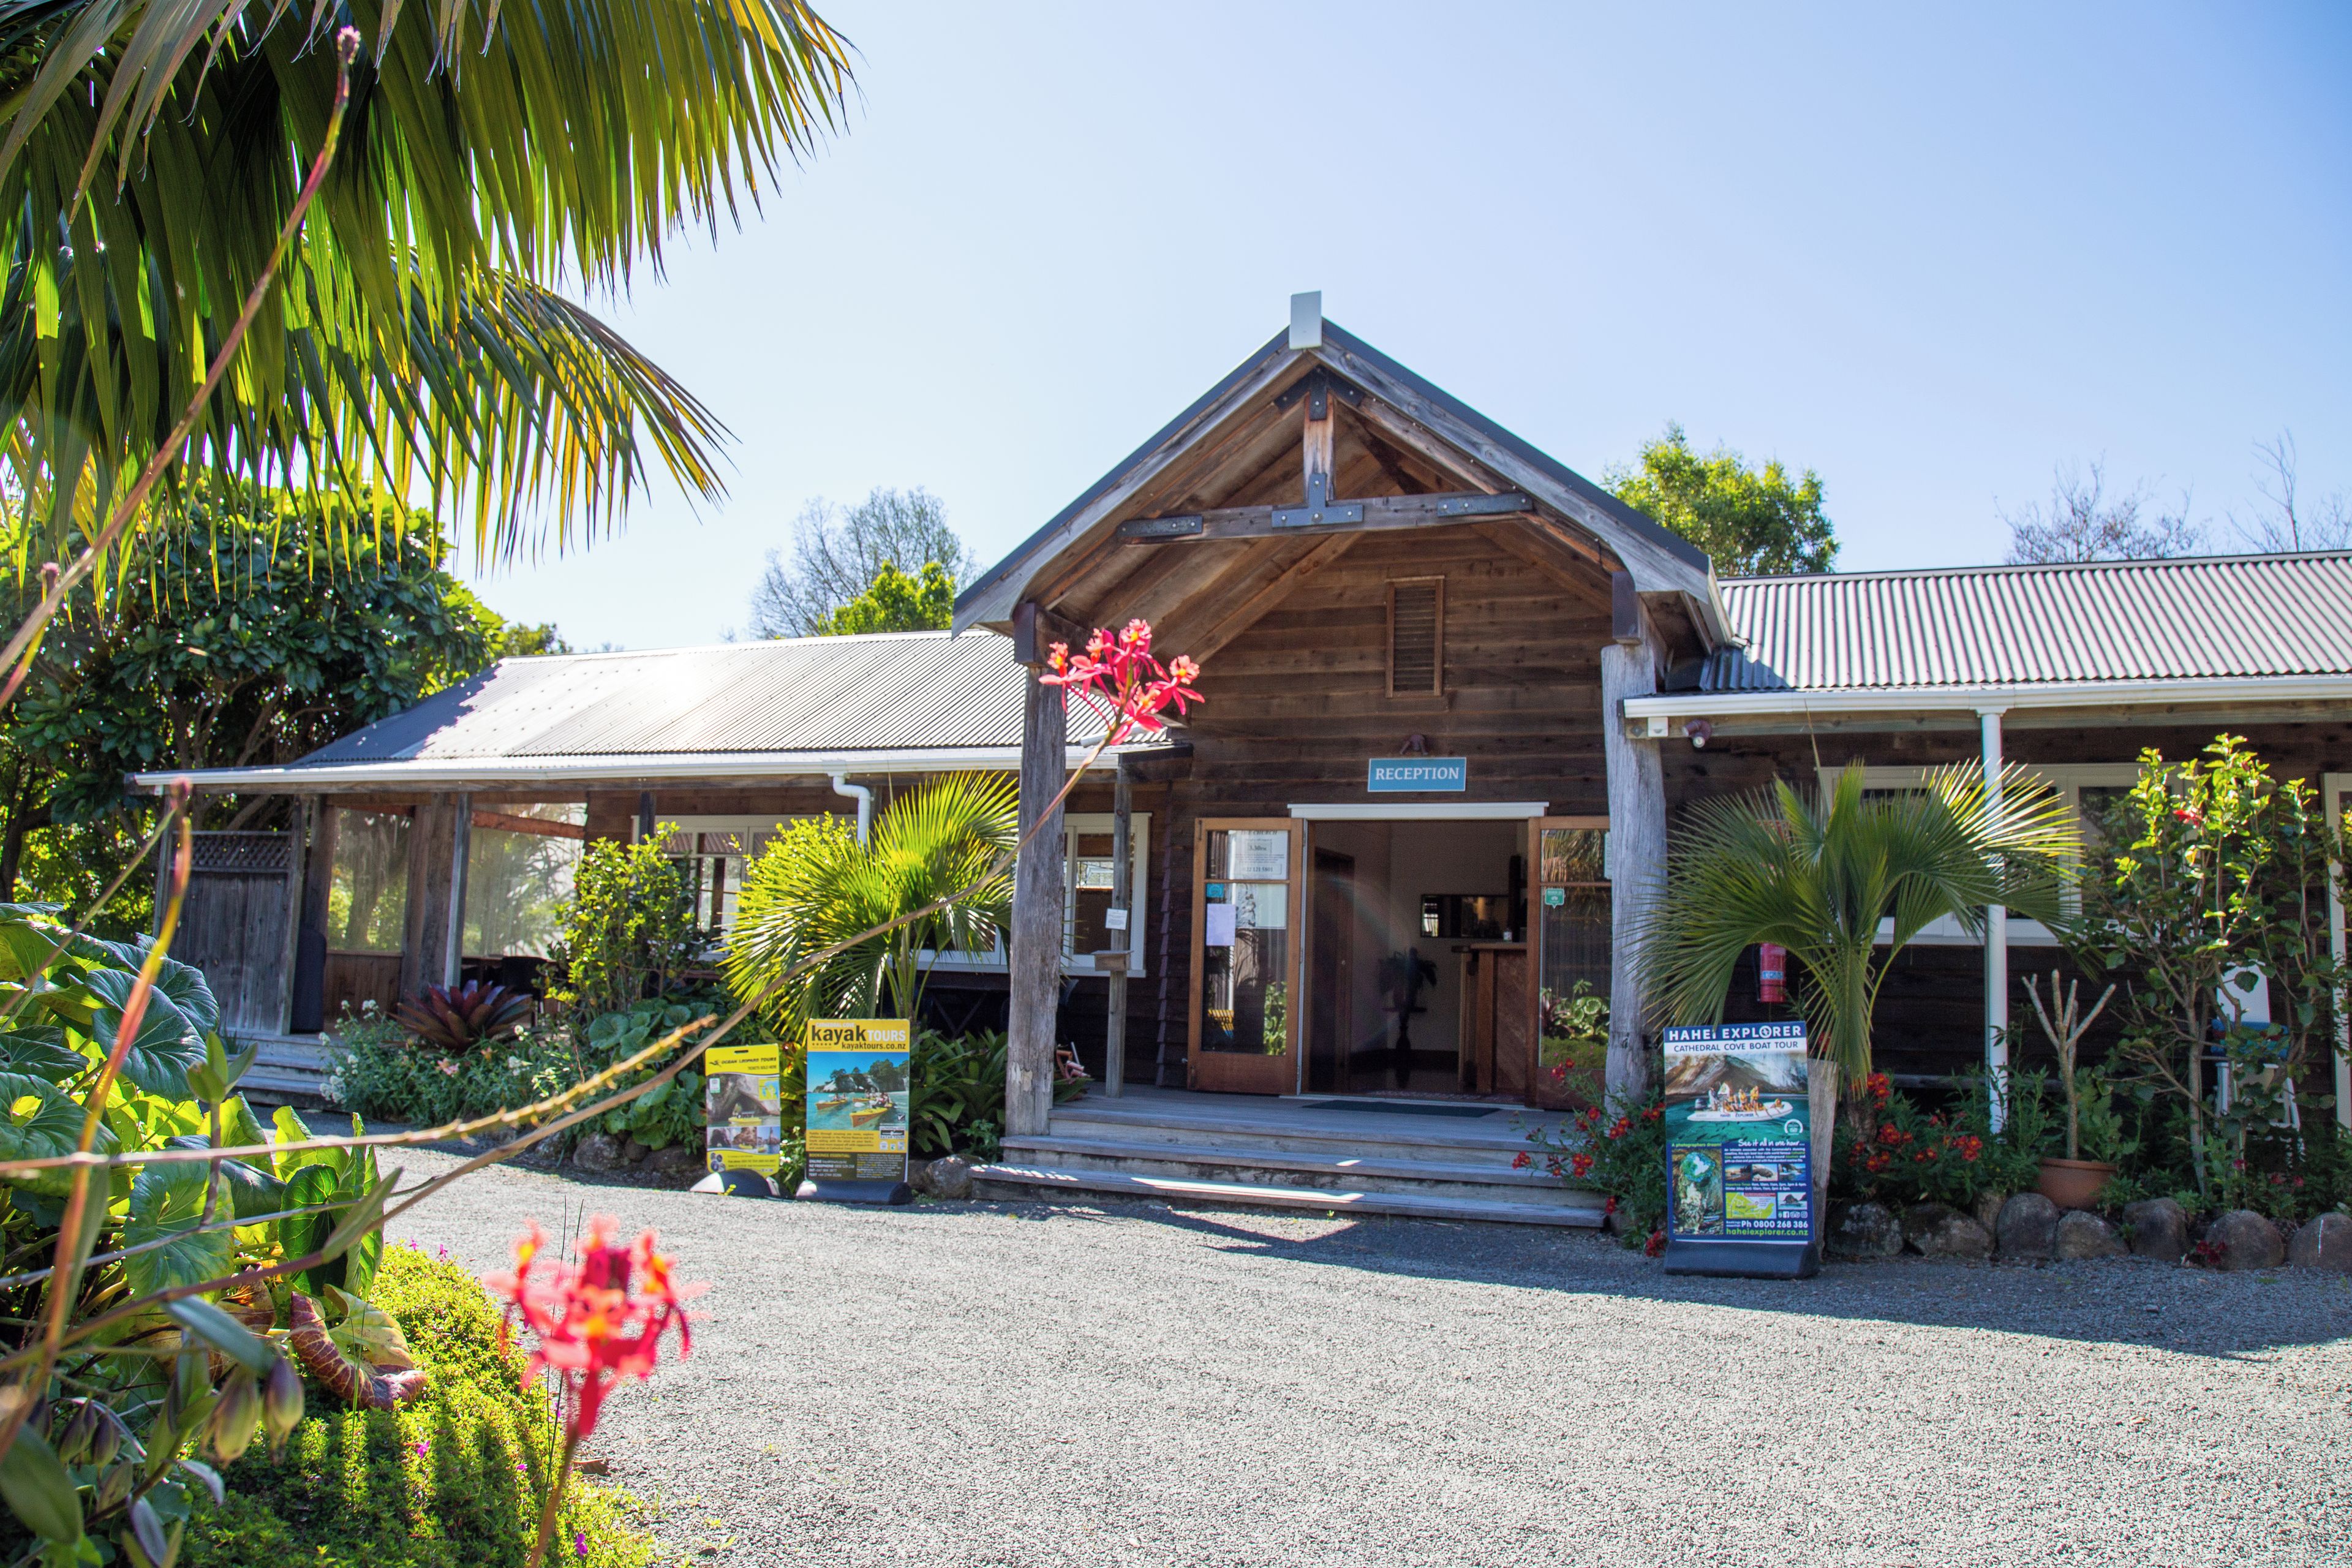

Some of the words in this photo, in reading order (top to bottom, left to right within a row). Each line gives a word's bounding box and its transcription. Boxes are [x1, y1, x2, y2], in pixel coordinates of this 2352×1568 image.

[1375, 767, 1460, 780] RECEPTION
[812, 1025, 866, 1045] kayak
[867, 1030, 906, 1041] TOURS
[1669, 1029, 1716, 1041] HAHEI
[1722, 1025, 1801, 1039] EXPLORER
[842, 1042, 906, 1051] kayaktours.co.nz
[1674, 1044, 1720, 1052] CATHEDRAL
[1726, 1228, 1809, 1237] haheiexplorer.co.nz
